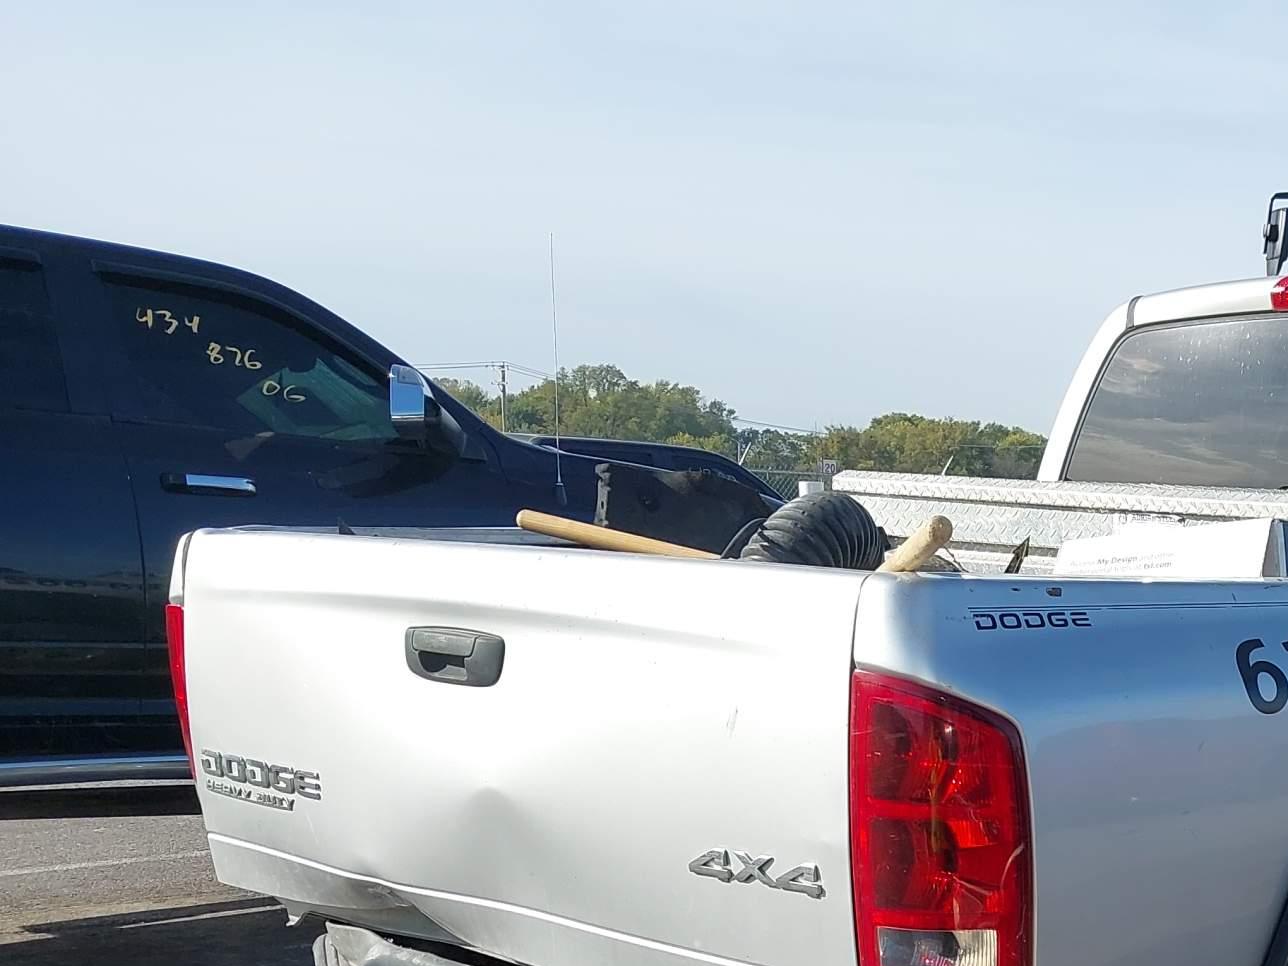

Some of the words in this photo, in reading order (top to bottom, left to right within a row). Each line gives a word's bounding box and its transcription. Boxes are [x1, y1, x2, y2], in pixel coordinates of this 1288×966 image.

[136, 307, 200, 334] 434
[206, 342, 262, 369] 876
[1111, 555, 1138, 565] Design
[972, 611, 1092, 630] DODGE
[200, 748, 322, 801] DODGE
[206, 778, 252, 799] HEAVY
[256, 792, 295, 811] DUTY
